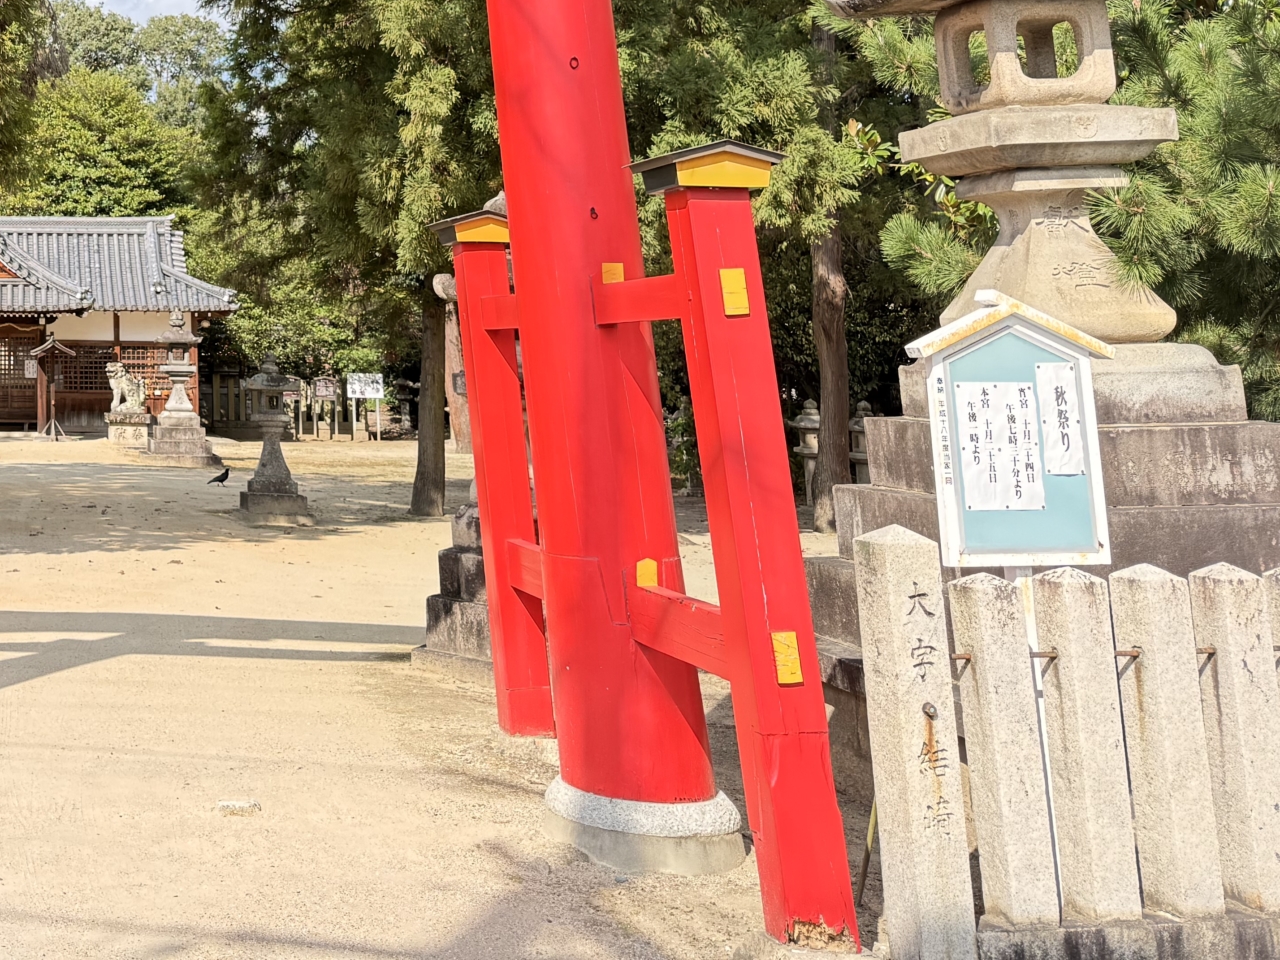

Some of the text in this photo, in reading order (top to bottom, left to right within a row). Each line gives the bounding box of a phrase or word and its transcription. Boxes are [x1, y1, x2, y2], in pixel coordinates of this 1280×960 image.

[966, 400, 980, 466] 午後一時より
[980, 386, 997, 483] 本宮 十月二十五日
[1005, 403, 1022, 500] 午後七時三十分より
[1021, 418, 1035, 483] 十月二十四日
[1053, 385, 1071, 453] 秋祭り
